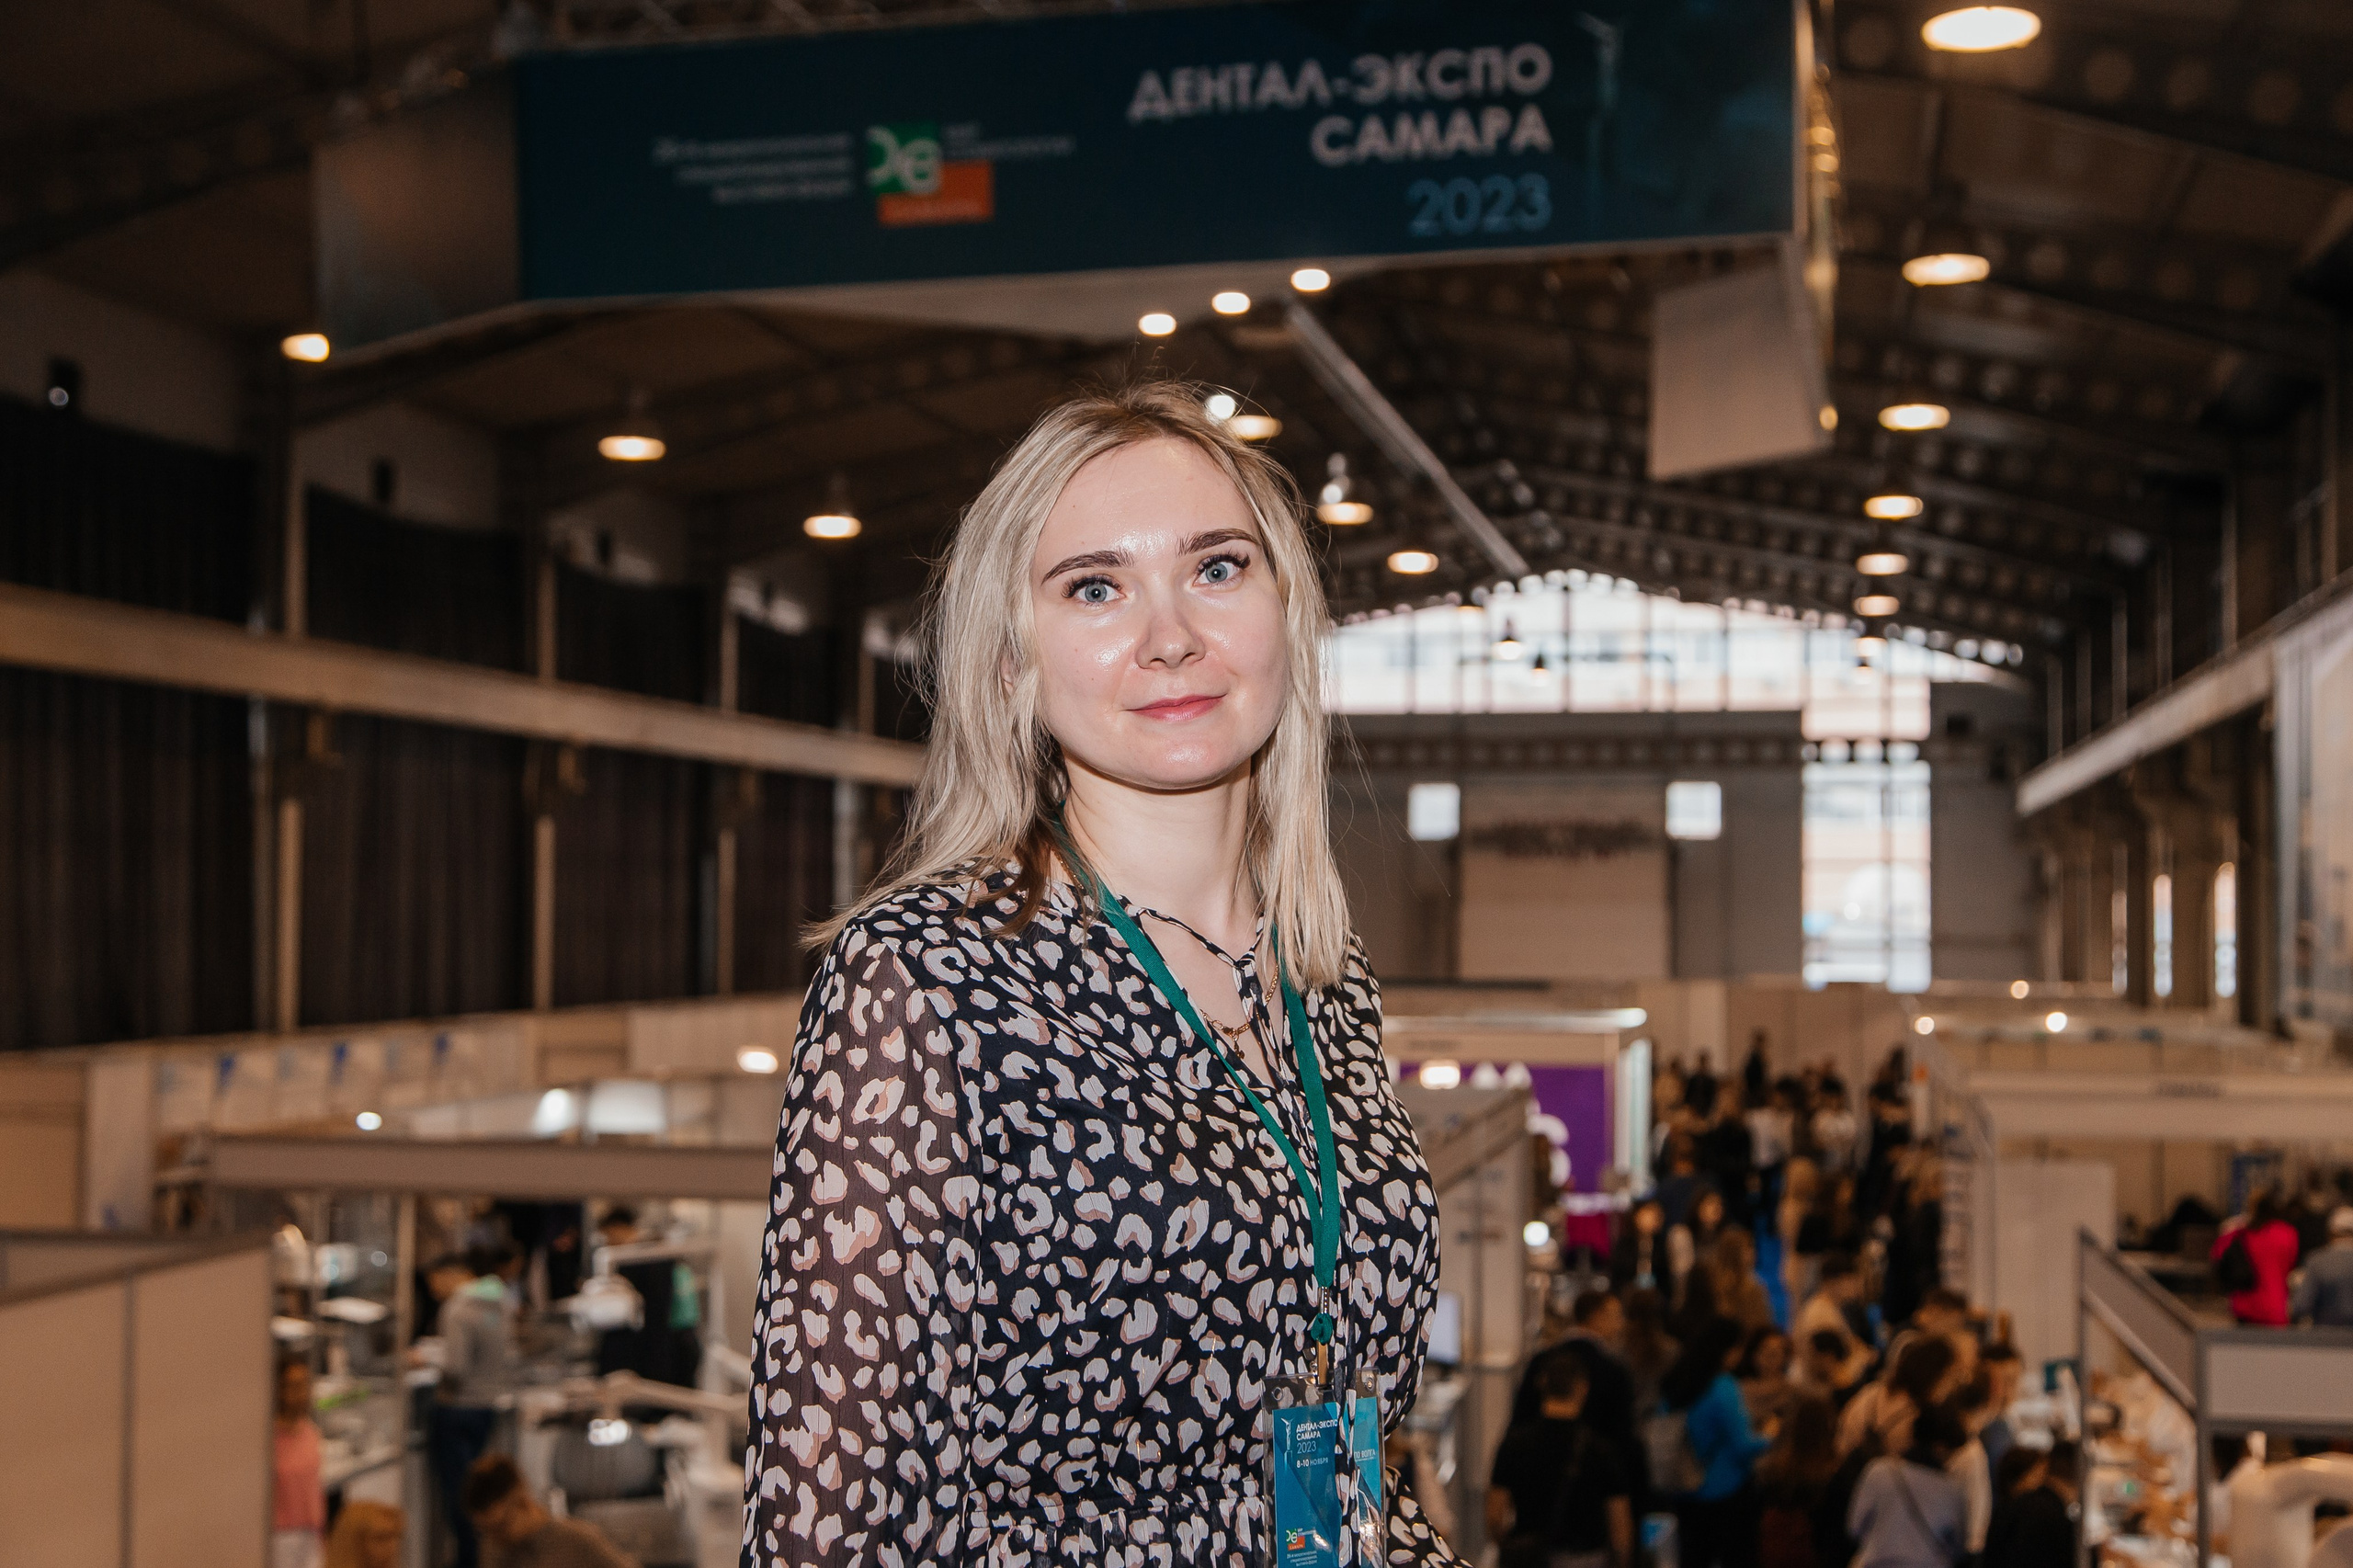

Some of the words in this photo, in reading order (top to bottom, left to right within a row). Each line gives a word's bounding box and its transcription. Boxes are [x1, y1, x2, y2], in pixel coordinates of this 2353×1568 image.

[1127, 42, 1552, 123] ДЕНТАЛ-ЭКСПО
[1310, 103, 1553, 167] САМАРА
[1407, 173, 1552, 236] 2023
[1296, 1419, 1338, 1433] ДЕНТАЛ-ЭКСПО
[1296, 1431, 1321, 1440] САМАРА
[1297, 1441, 1316, 1454] 2023
[1310, 1457, 1328, 1466] НОЯБРЯ
